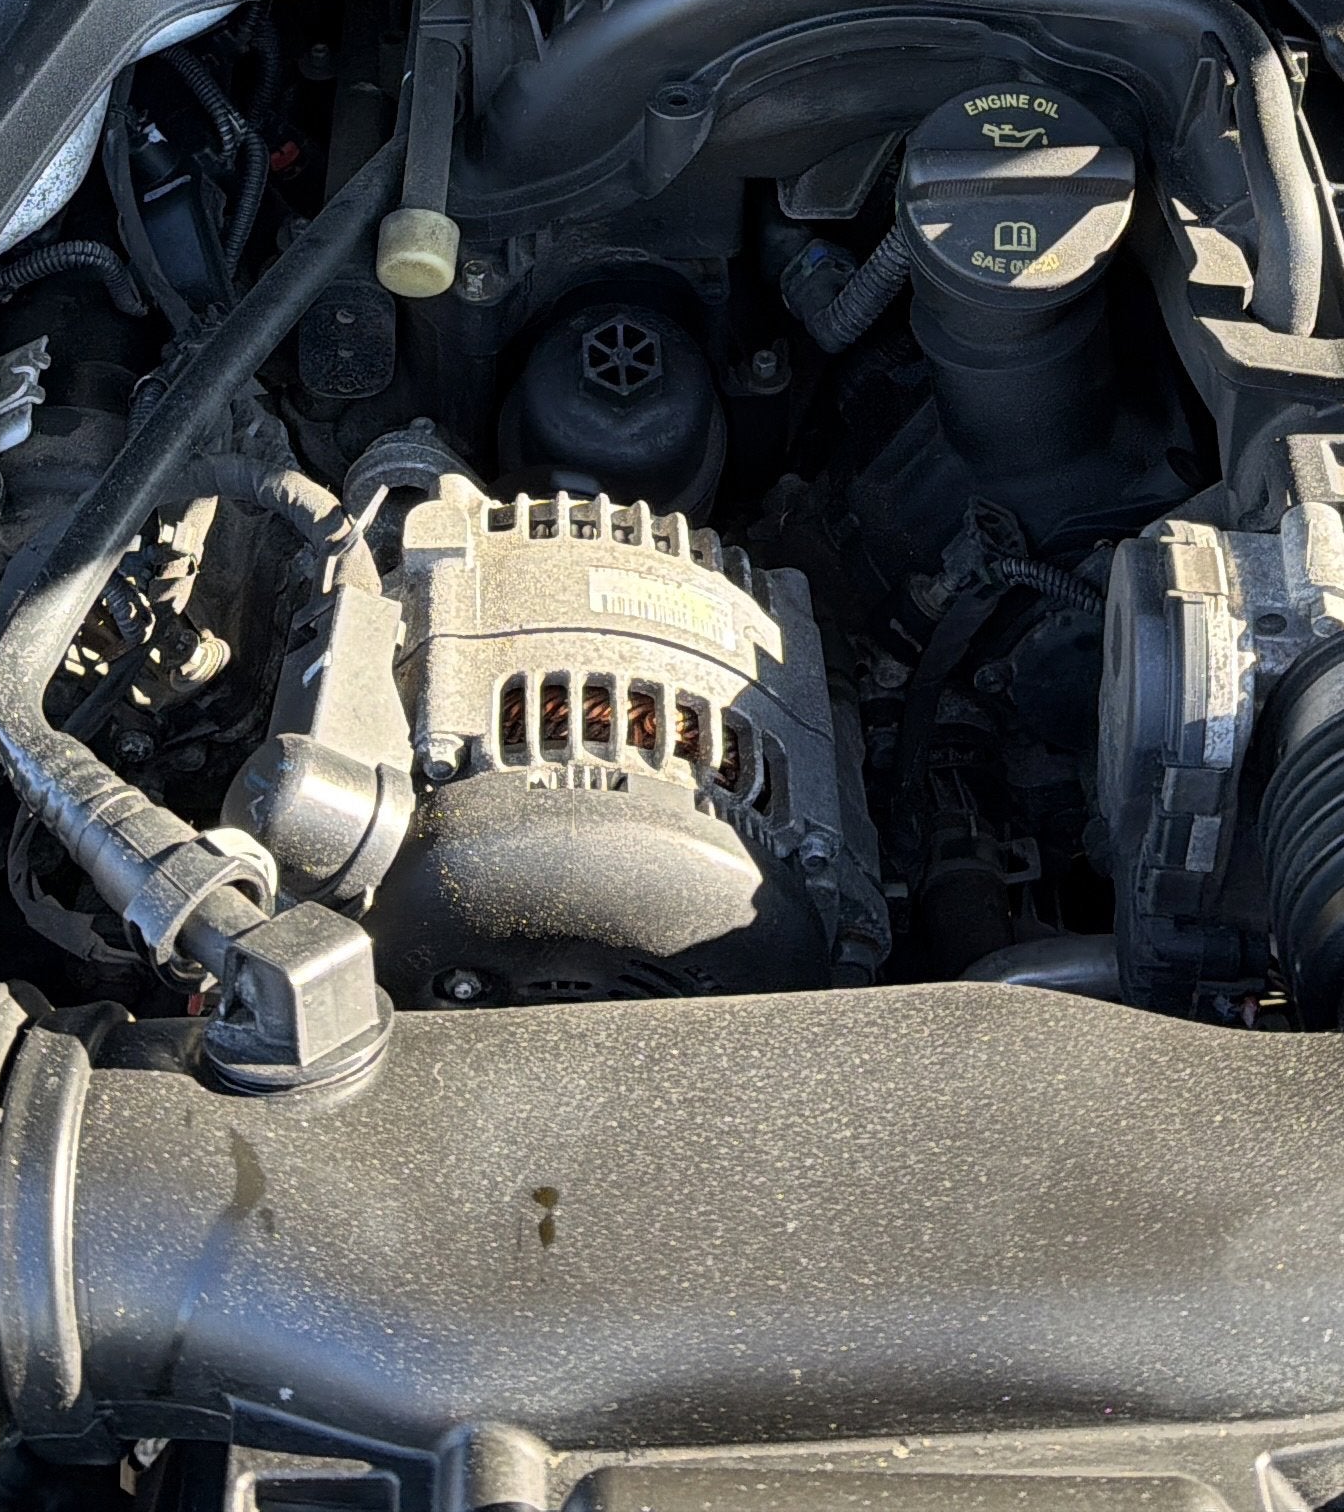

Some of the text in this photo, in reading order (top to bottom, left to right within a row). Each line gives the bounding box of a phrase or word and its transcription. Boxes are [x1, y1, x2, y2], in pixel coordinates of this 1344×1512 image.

[964, 94, 1059, 118] ENGINE OIL
[971, 251, 1007, 274] SAE
